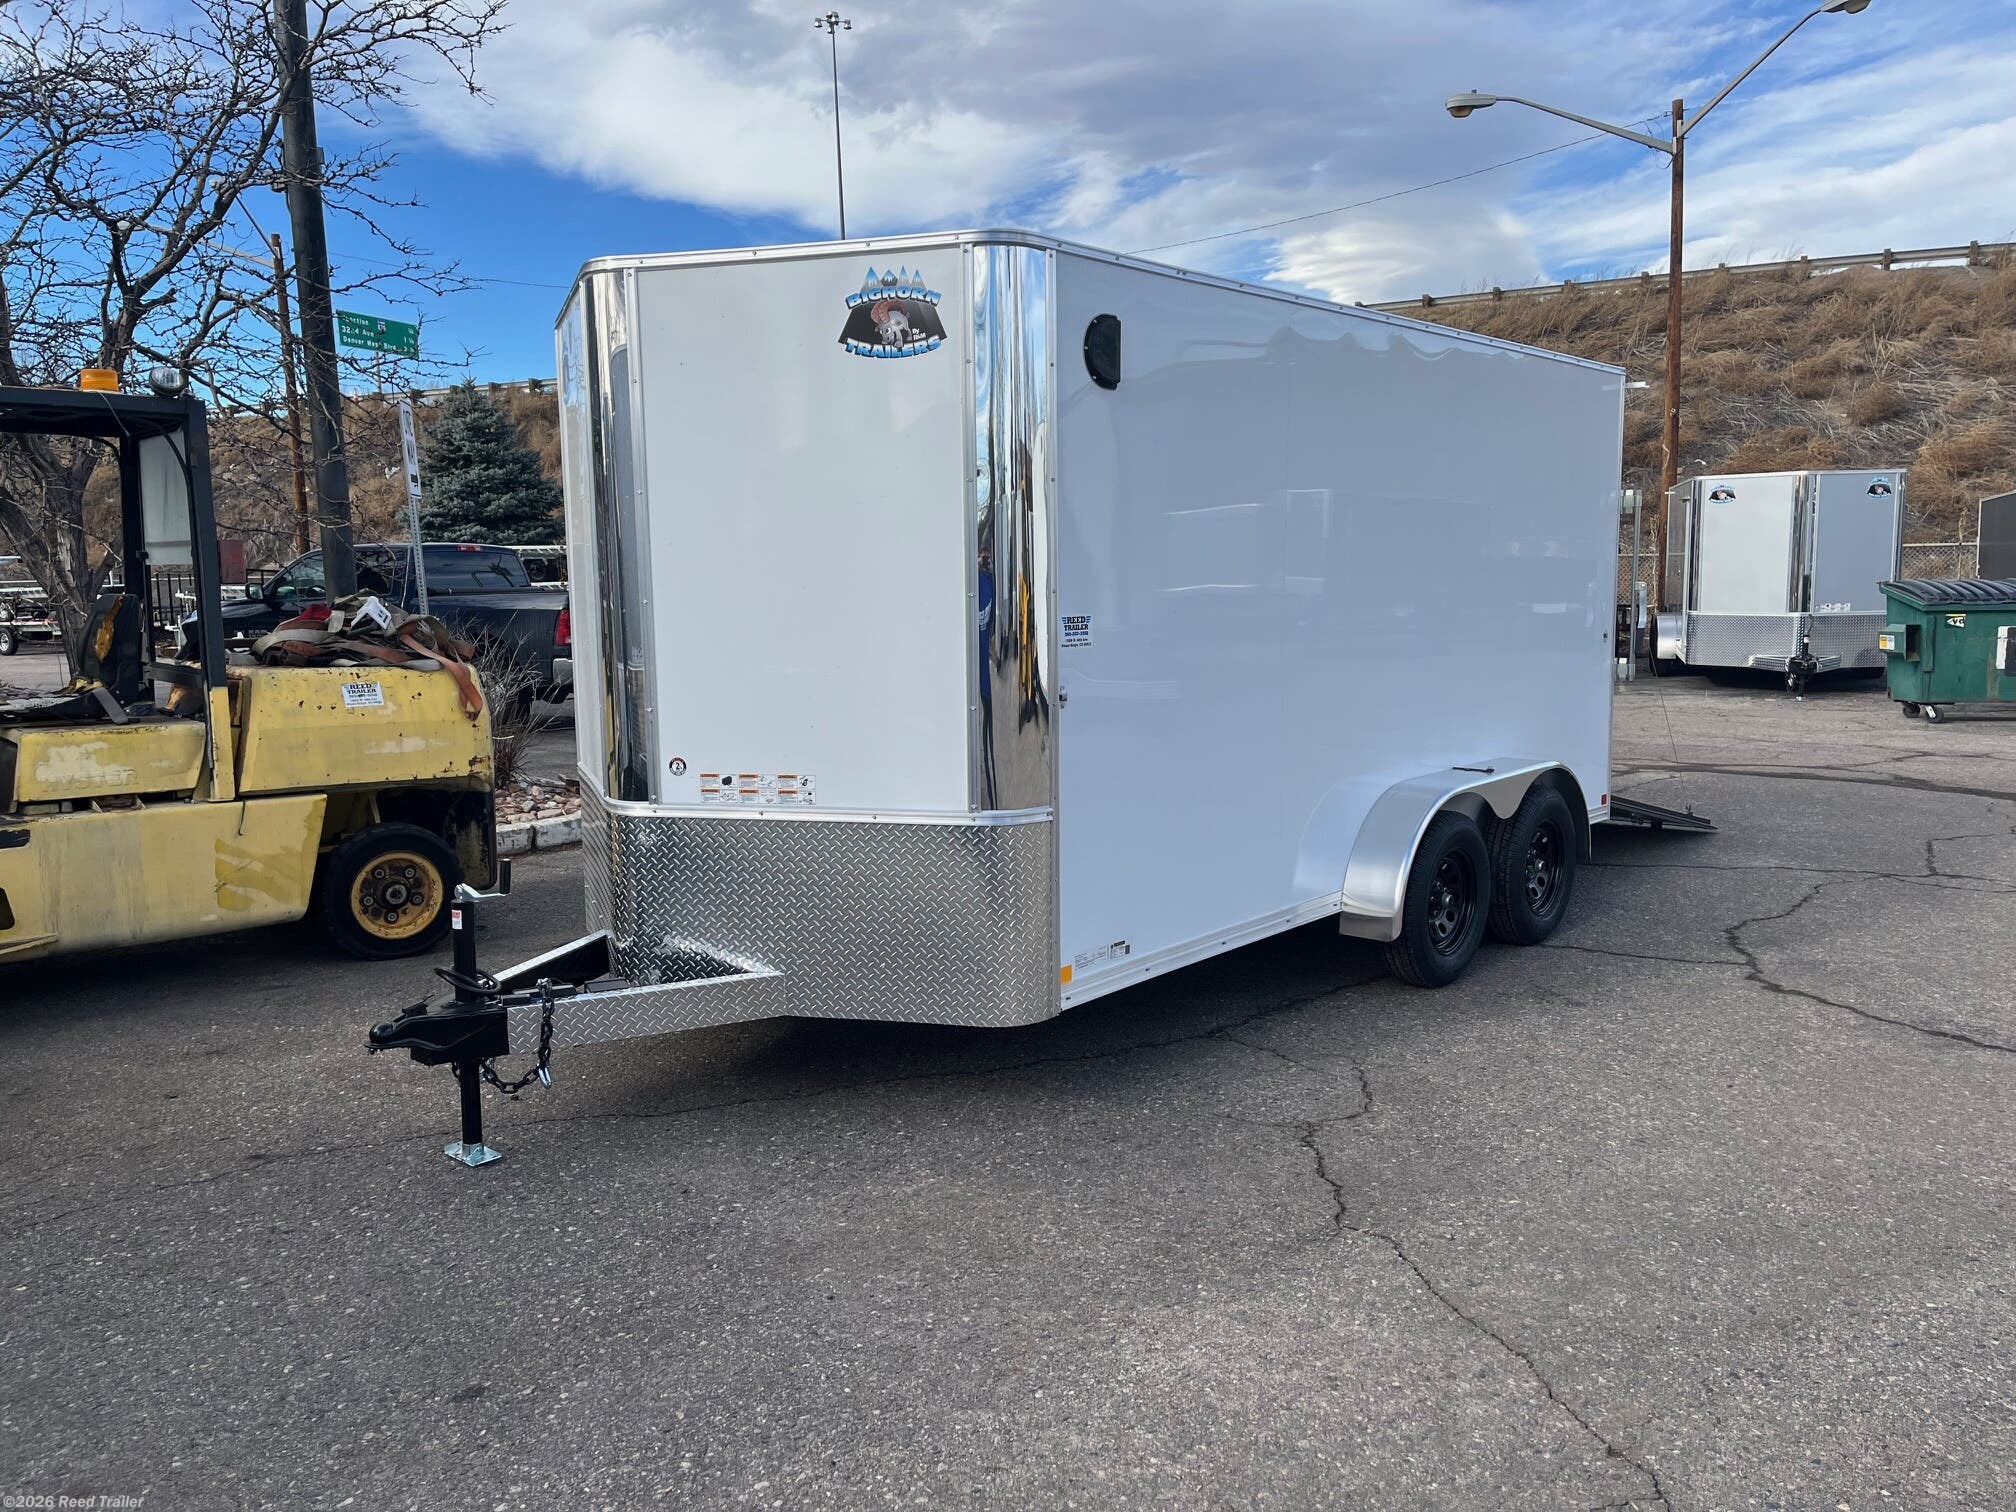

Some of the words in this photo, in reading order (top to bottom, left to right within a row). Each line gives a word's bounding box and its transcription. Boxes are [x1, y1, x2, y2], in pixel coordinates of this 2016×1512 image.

[845, 286, 942, 310] BIGHORN
[362, 329, 375, 338] Ave
[342, 336, 365, 345] Denver
[844, 335, 942, 358] TRAILERS
[1066, 616, 1086, 624] REED
